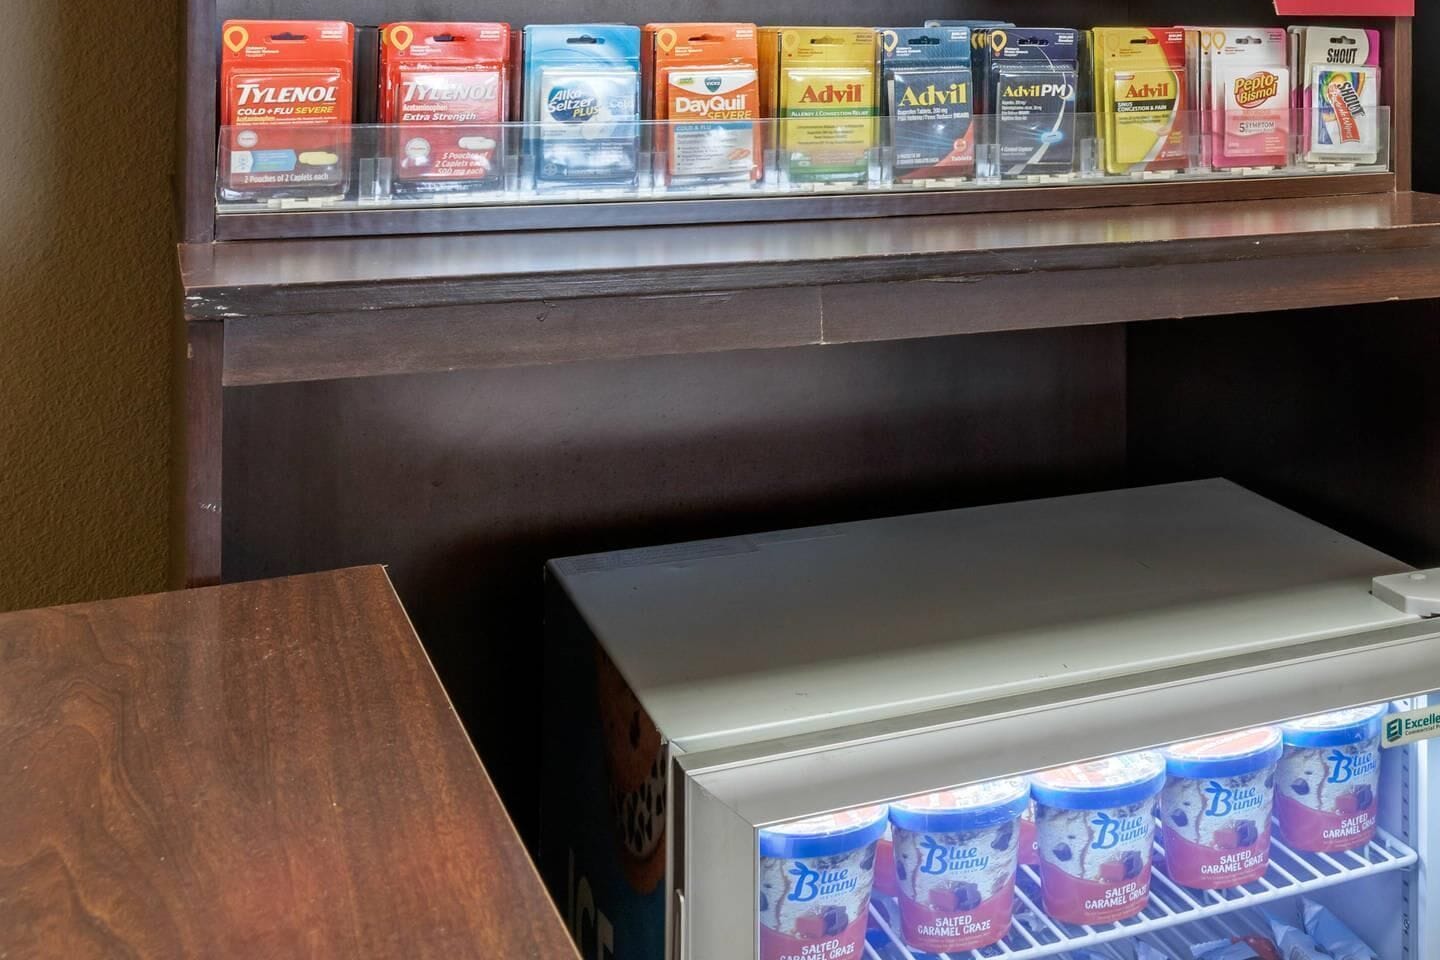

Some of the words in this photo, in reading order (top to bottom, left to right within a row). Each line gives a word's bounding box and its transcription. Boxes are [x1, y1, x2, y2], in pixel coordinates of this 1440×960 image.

[1327, 48, 1358, 64] SHOUT
[1126, 83, 1168, 98] Advil
[1234, 74, 1279, 94] Pepto-
[236, 84, 336, 106] TYLENOL
[402, 82, 496, 102] TYLENOL
[552, 89, 583, 101] Alka
[799, 84, 862, 104] Advil
[898, 83, 967, 107] Advil
[1239, 87, 1277, 104] Bismol
[295, 106, 335, 114] SEVERE
[549, 97, 594, 113] Seltzer
[573, 106, 599, 118] PLUS
[676, 95, 746, 116] DayQuil
[402, 113, 430, 121] Extra
[432, 113, 476, 122] Strength
[707, 110, 752, 119] SEVERE
[1405, 726, 1435, 736] Commercial
[1341, 813, 1368, 828] SALTED
[1323, 826, 1360, 838] CARAMEL
[1220, 850, 1251, 865] SALTED
[1201, 862, 1242, 874] CARAMEL
[1105, 882, 1137, 899] SALTED
[1085, 895, 1127, 910] CARAMEL
[918, 922, 962, 937] CARAMEL
[963, 919, 991, 935] CRAZE
[935, 915, 972, 927] SALTED
[802, 940, 840, 955] SALTED
[829, 942, 855, 959] CRAZE
